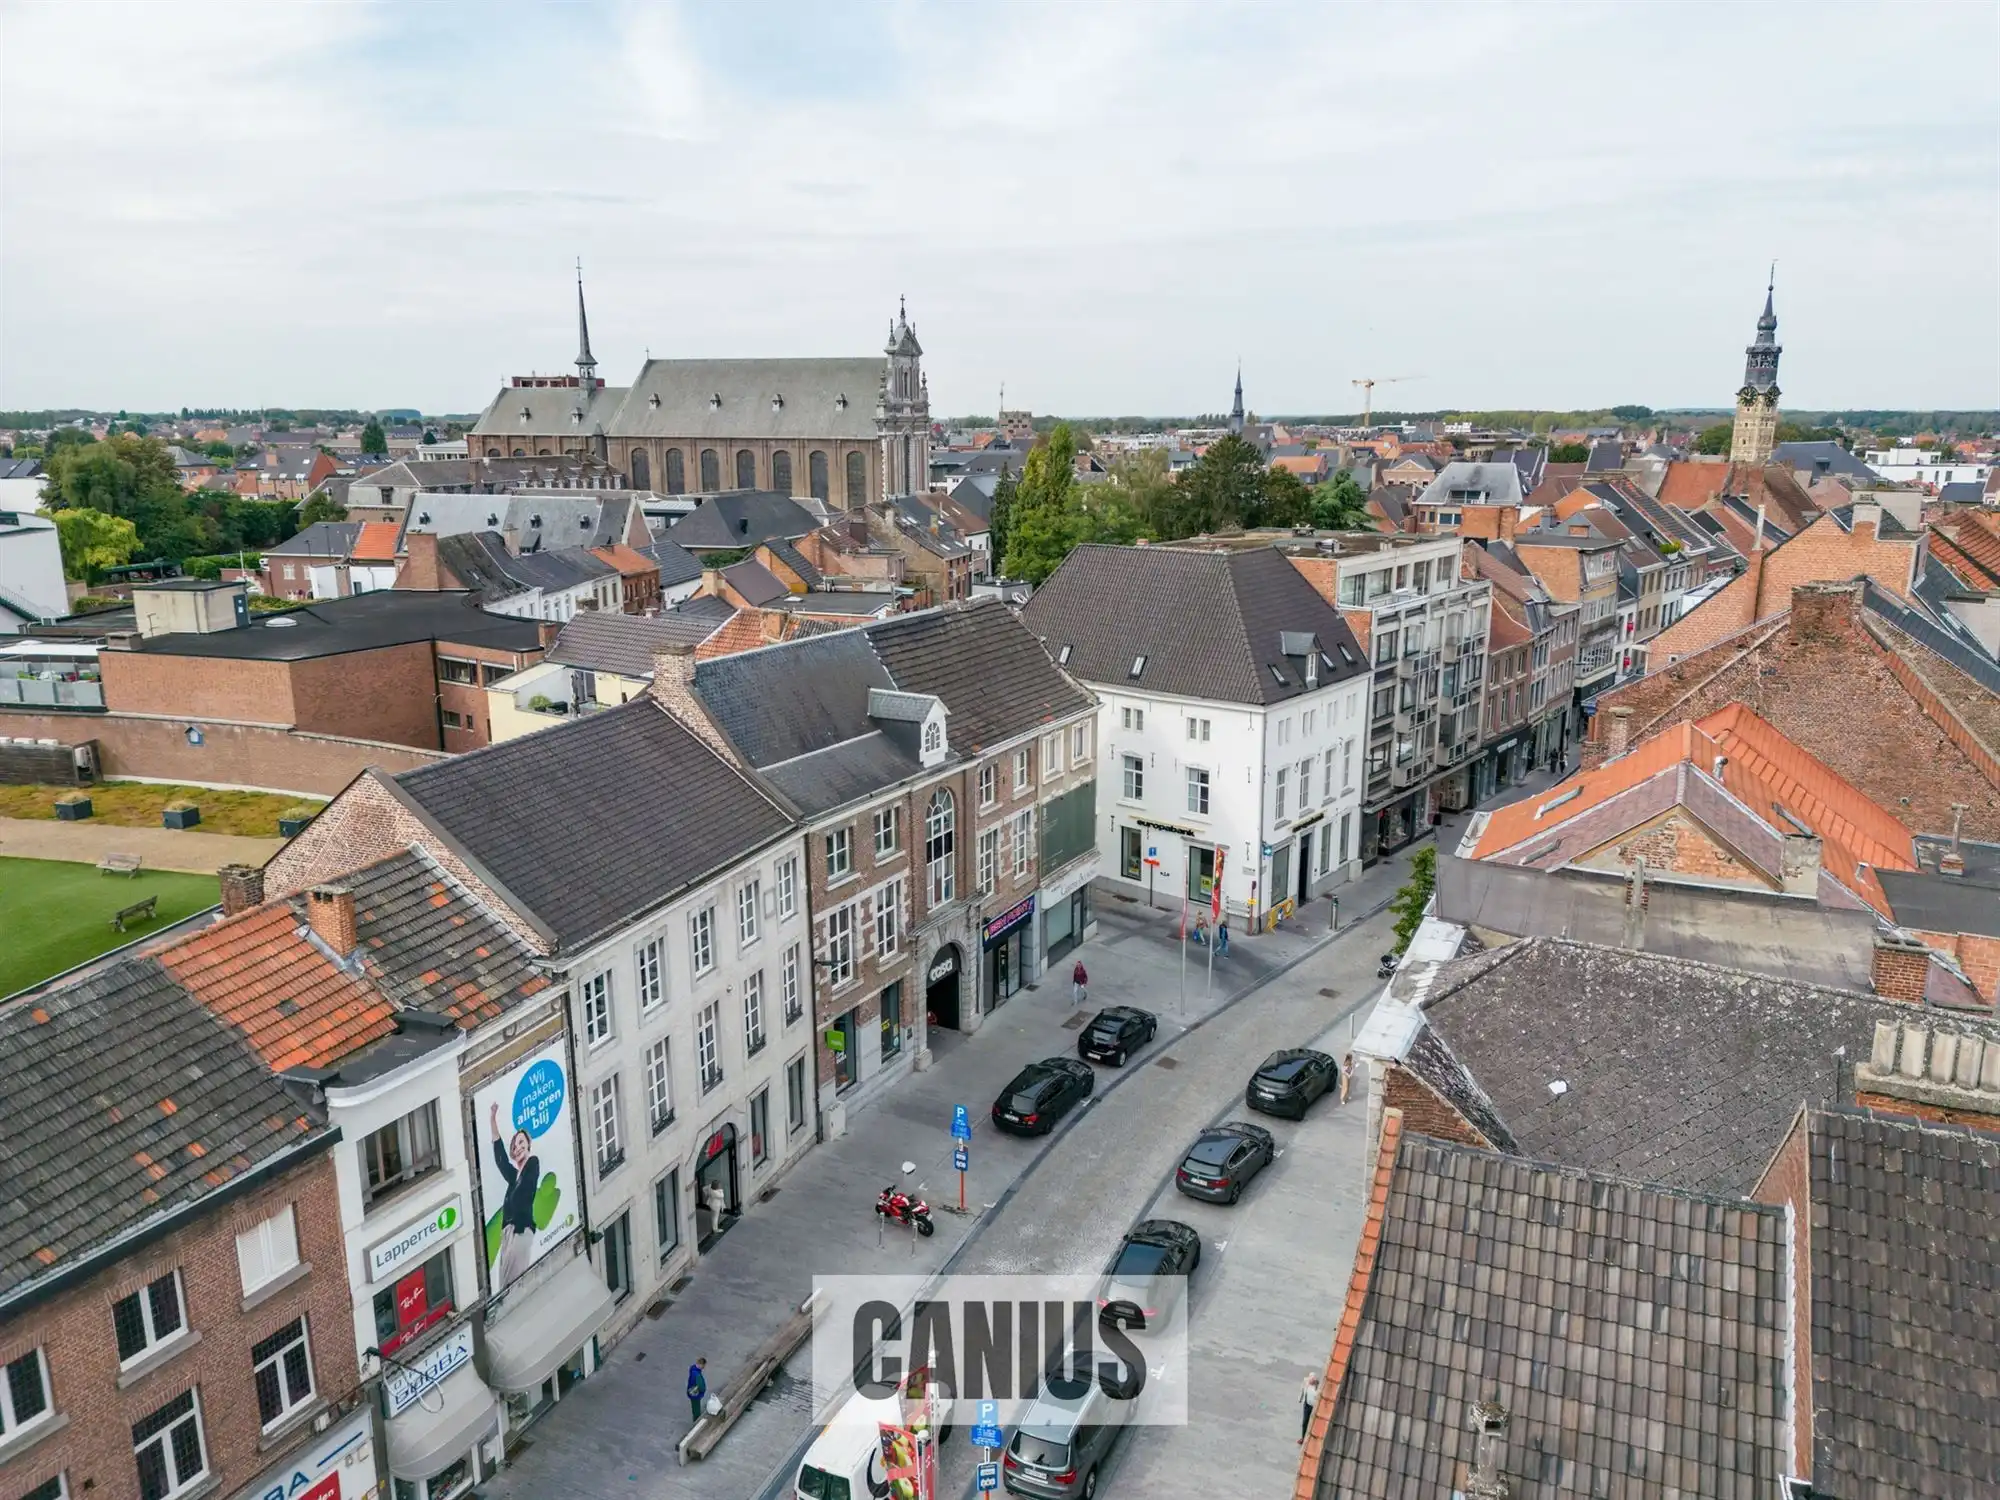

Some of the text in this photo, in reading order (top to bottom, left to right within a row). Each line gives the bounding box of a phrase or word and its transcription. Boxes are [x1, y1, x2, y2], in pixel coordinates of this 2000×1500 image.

[1137, 819, 1195, 837] europabank
[930, 957, 953, 982] casa
[529, 1067, 545, 1086] Wij
[522, 1080, 555, 1107] maken
[517, 1089, 561, 1126] alle oren
[956, 1107, 965, 1118] P
[532, 1108, 549, 1130] blij
[376, 1221, 437, 1268] Lapperre
[982, 1403, 994, 1419] P
